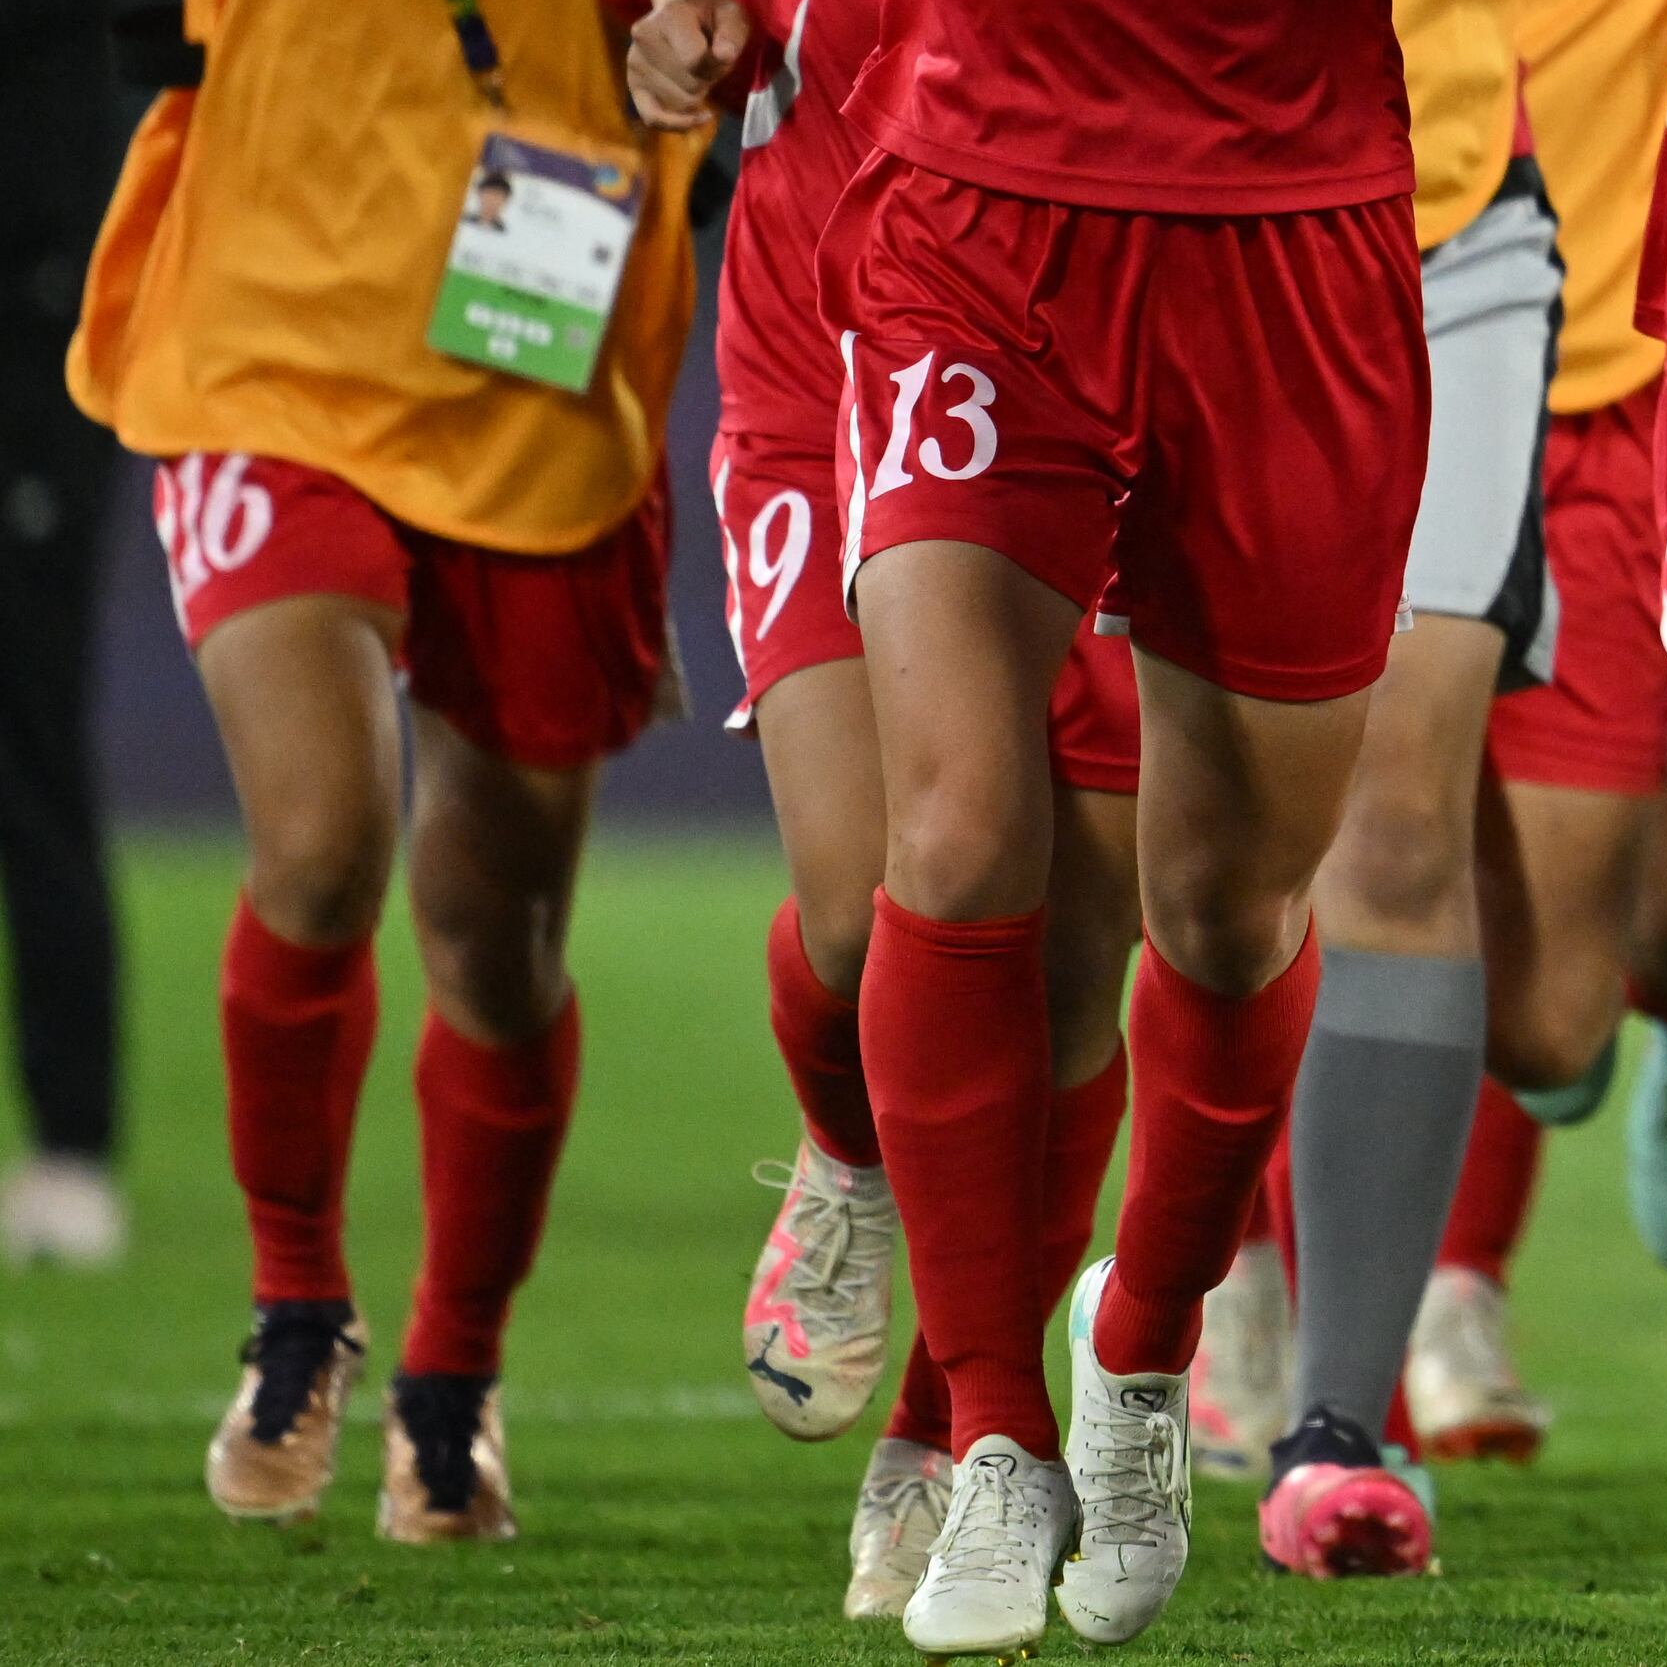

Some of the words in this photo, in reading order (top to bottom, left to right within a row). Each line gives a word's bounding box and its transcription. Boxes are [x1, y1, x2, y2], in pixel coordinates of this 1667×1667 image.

[868, 350, 998, 499] 13
[176, 450, 274, 594] 16
[748, 488, 812, 641] 9
